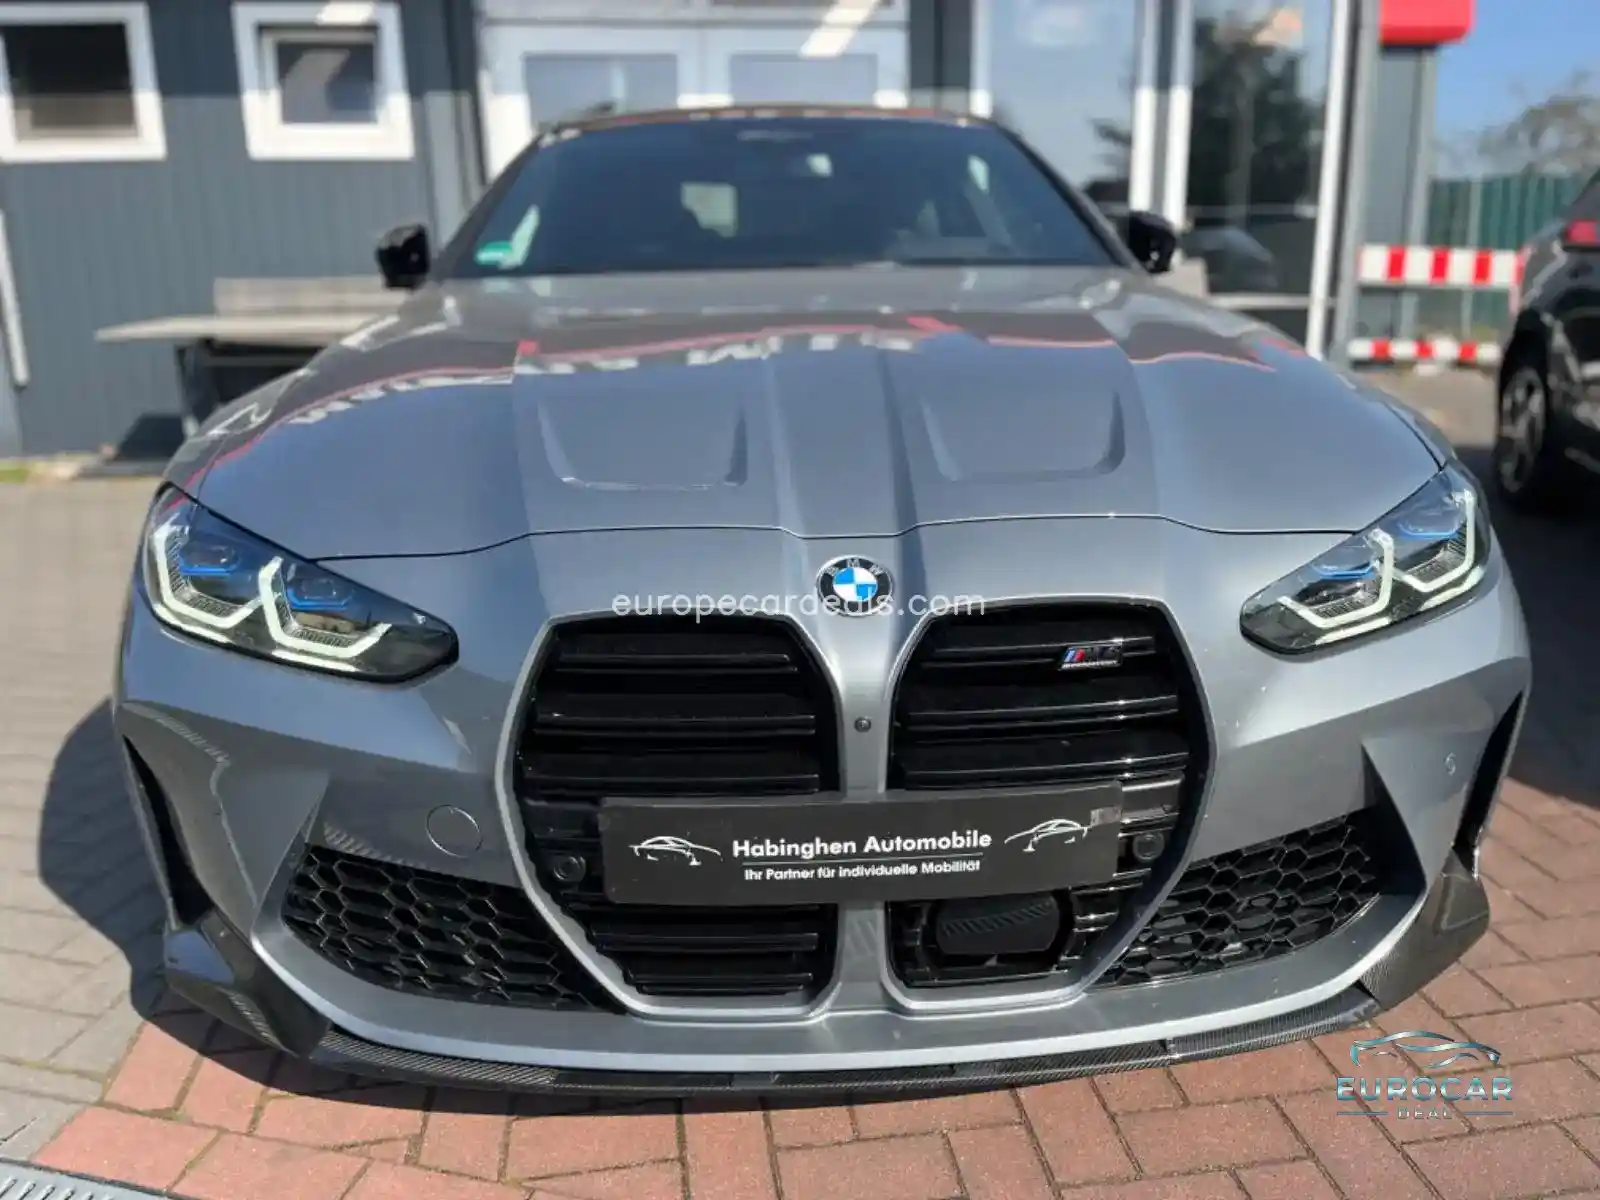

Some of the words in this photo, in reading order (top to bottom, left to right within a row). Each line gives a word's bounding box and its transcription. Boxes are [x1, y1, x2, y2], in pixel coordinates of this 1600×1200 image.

[732, 836, 857, 860] Habinghen
[863, 829, 993, 853] Automobile
[744, 869, 762, 881] Ihr
[765, 867, 815, 880] Partner
[817, 865, 836, 879] für
[838, 863, 918, 878] individuelle
